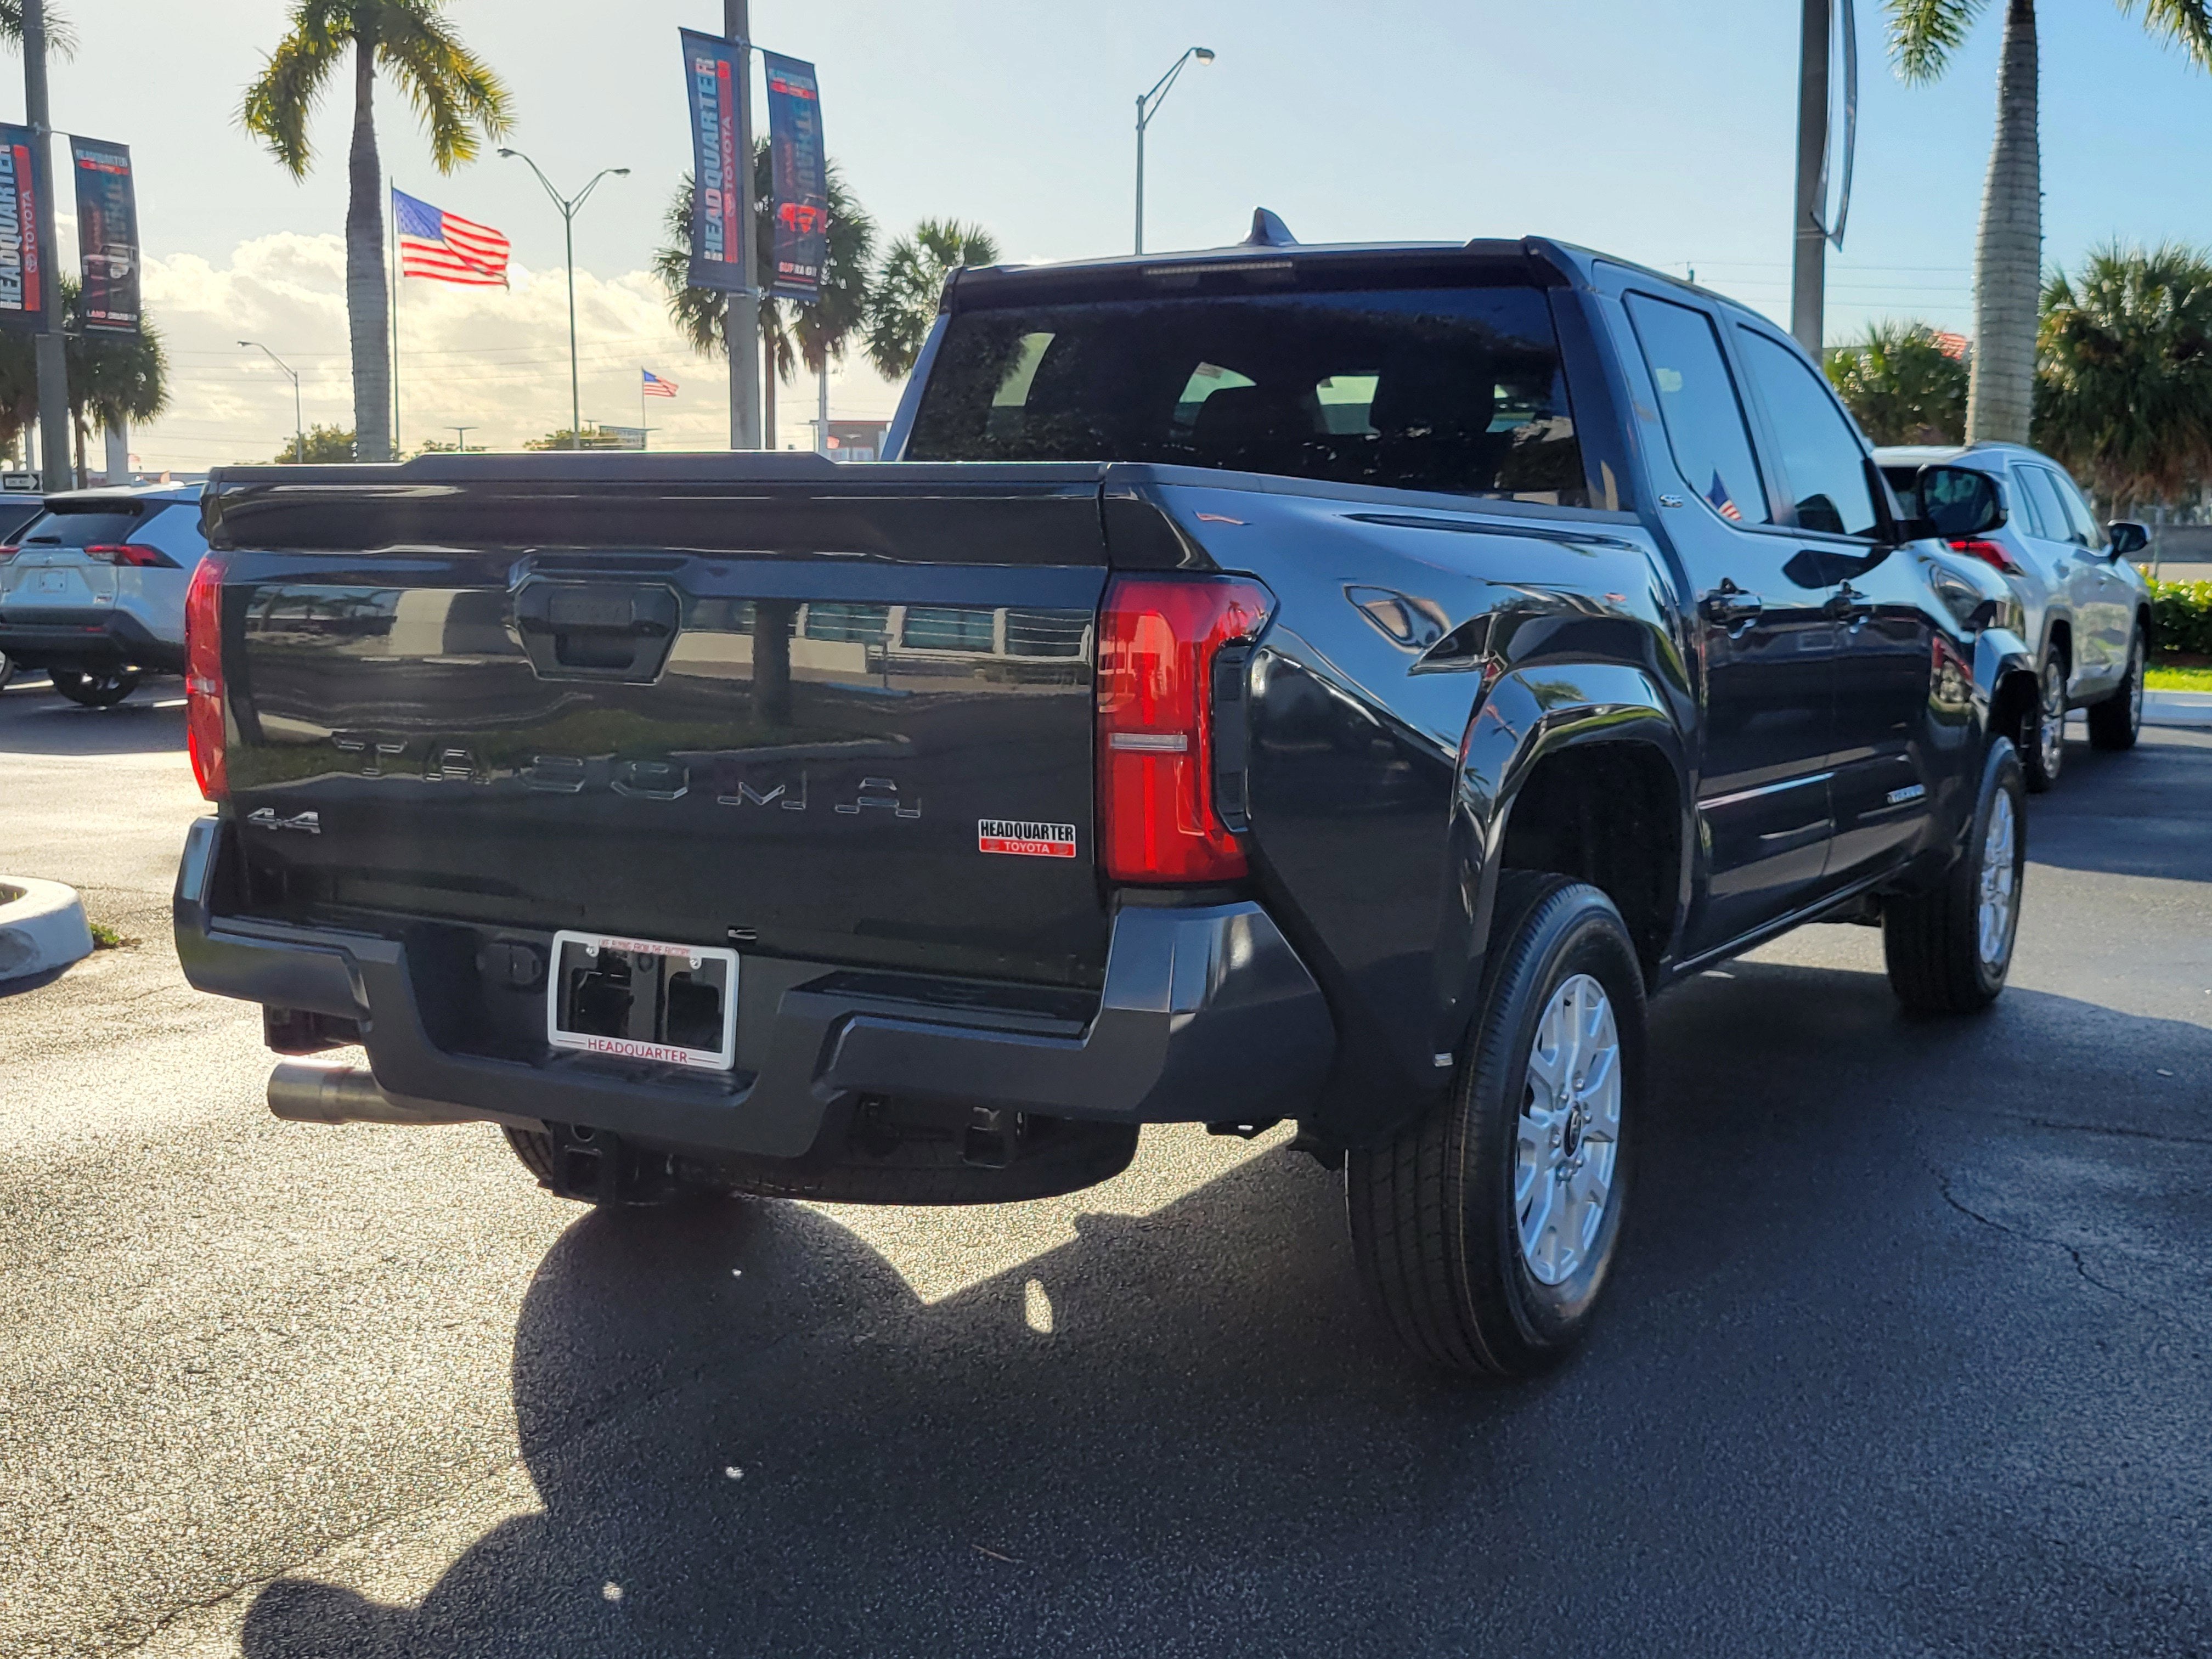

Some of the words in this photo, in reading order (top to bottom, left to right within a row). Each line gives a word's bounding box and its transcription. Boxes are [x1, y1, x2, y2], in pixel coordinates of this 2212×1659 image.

[696, 57, 723, 262] HEADQUARTER
[721, 117, 733, 190] TOYOTA
[22, 190, 35, 251] TOYOTA
[980, 821, 1074, 842] HEADQUARTER
[1004, 842, 1050, 854] TOYOTA
[588, 1038, 688, 1063] HEADQUARTER
